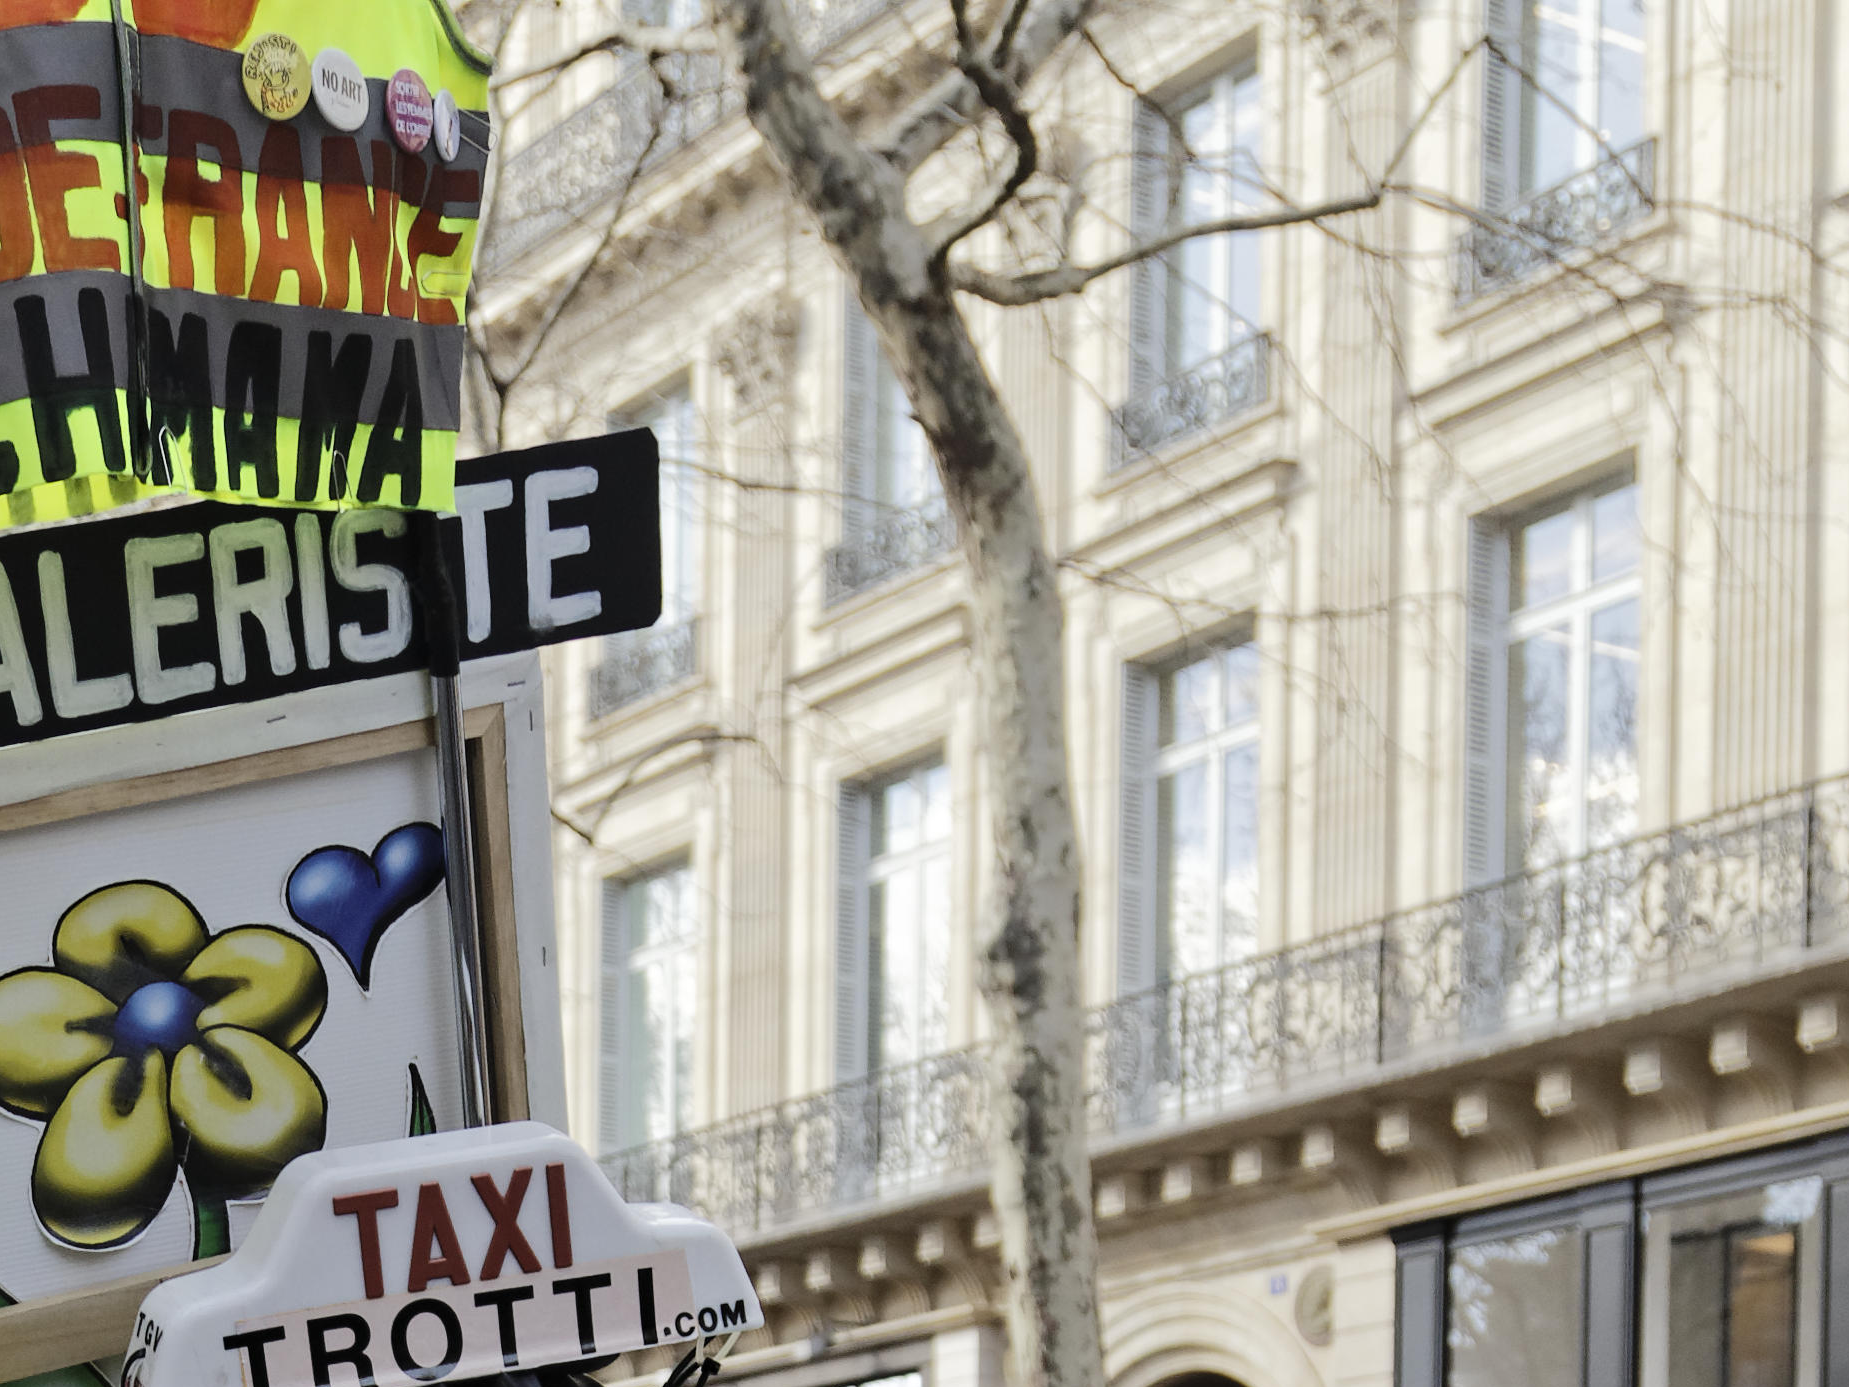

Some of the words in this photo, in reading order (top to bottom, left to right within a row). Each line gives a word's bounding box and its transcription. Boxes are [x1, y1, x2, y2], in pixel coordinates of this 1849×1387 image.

[322, 68, 339, 92] NO
[341, 76, 363, 104] ART
[332, 1164, 573, 1299] TAXI
[137, 1312, 163, 1352] TGV
